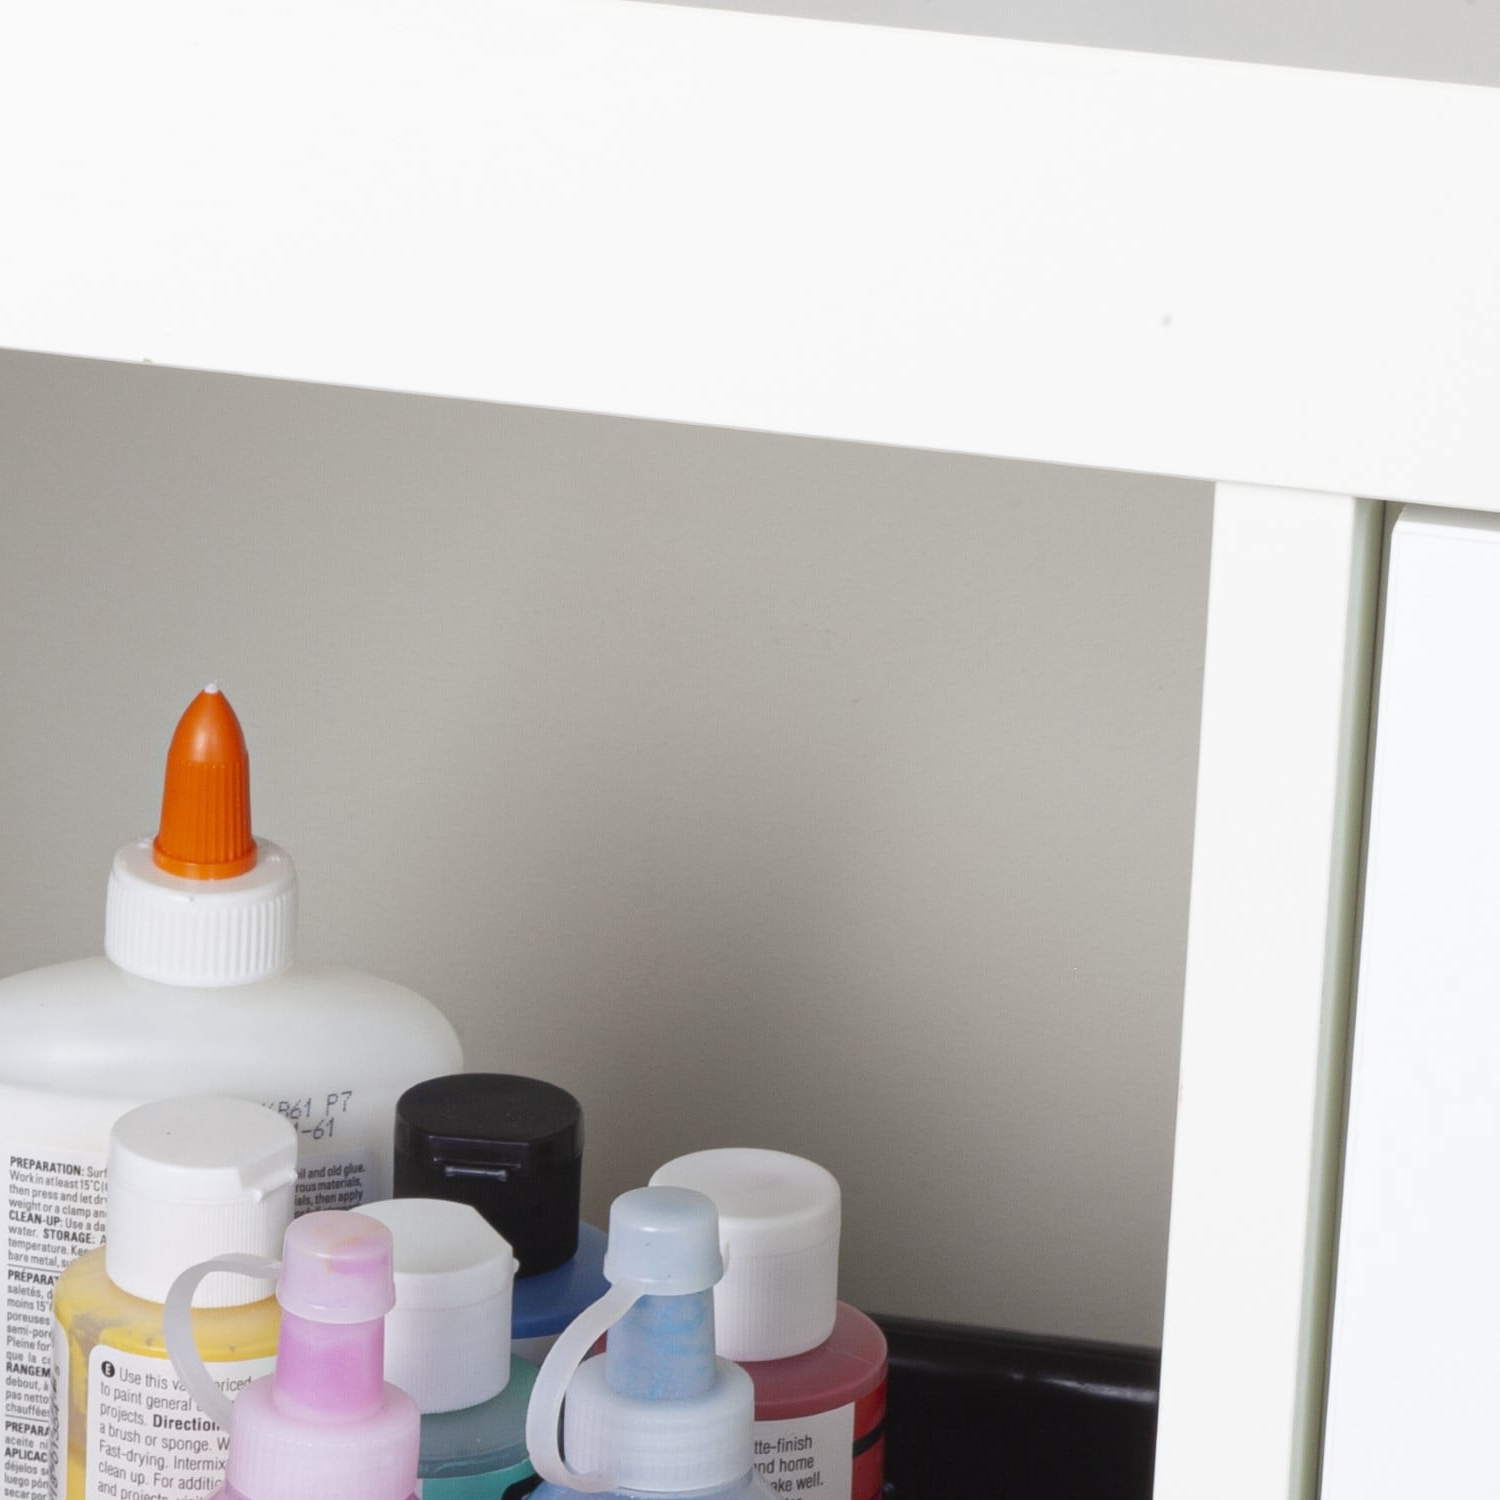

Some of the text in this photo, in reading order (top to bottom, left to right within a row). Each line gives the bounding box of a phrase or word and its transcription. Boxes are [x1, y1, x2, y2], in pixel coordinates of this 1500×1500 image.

[325, 1090, 353, 1117] P7
[9, 1155, 85, 1176] PREPARATION:
[308, 1166, 326, 1179] and
[55, 1176, 79, 1189] least
[9, 1184, 92, 1204] then press and let
[315, 1193, 337, 1205] then
[9, 1199, 91, 1219] weight or a clamp
[9, 1209, 63, 1228] CLEAN-UP:
[65, 1218, 83, 1231] Use
[85, 1220, 92, 1231] a
[8, 1225, 96, 1245] water. STORAGE:
[8, 1237, 69, 1256] temperature.
[8, 1250, 60, 1268] bare metal,
[7, 1298, 35, 1310] moins
[7, 1311, 50, 1326] poreuses
[6, 1335, 35, 1349] Pleine
[6, 1350, 37, 1363] que la
[5, 1375, 41, 1391] debout,
[119, 1367, 142, 1385] Use
[145, 1373, 168, 1390] this
[5, 1390, 22, 1402] pas
[100, 1381, 192, 1412] to paint general
[100, 1402, 148, 1426] projects.
[5, 1436, 34, 1448] aceite
[99, 1422, 105, 1434] a
[108, 1423, 141, 1444] brush
[145, 1434, 157, 1447] or
[161, 1437, 212, 1454] sponge.
[4, 1448, 47, 1463] APLICAC
[99, 1439, 169, 1471] Fast-drying.
[779, 1456, 814, 1473] home
[4, 1472, 29, 1487] luego
[98, 1461, 174, 1489] clean up. For
[796, 1470, 824, 1490] well.
[4, 1486, 30, 1499] secar
[97, 1480, 117, 1497] and
